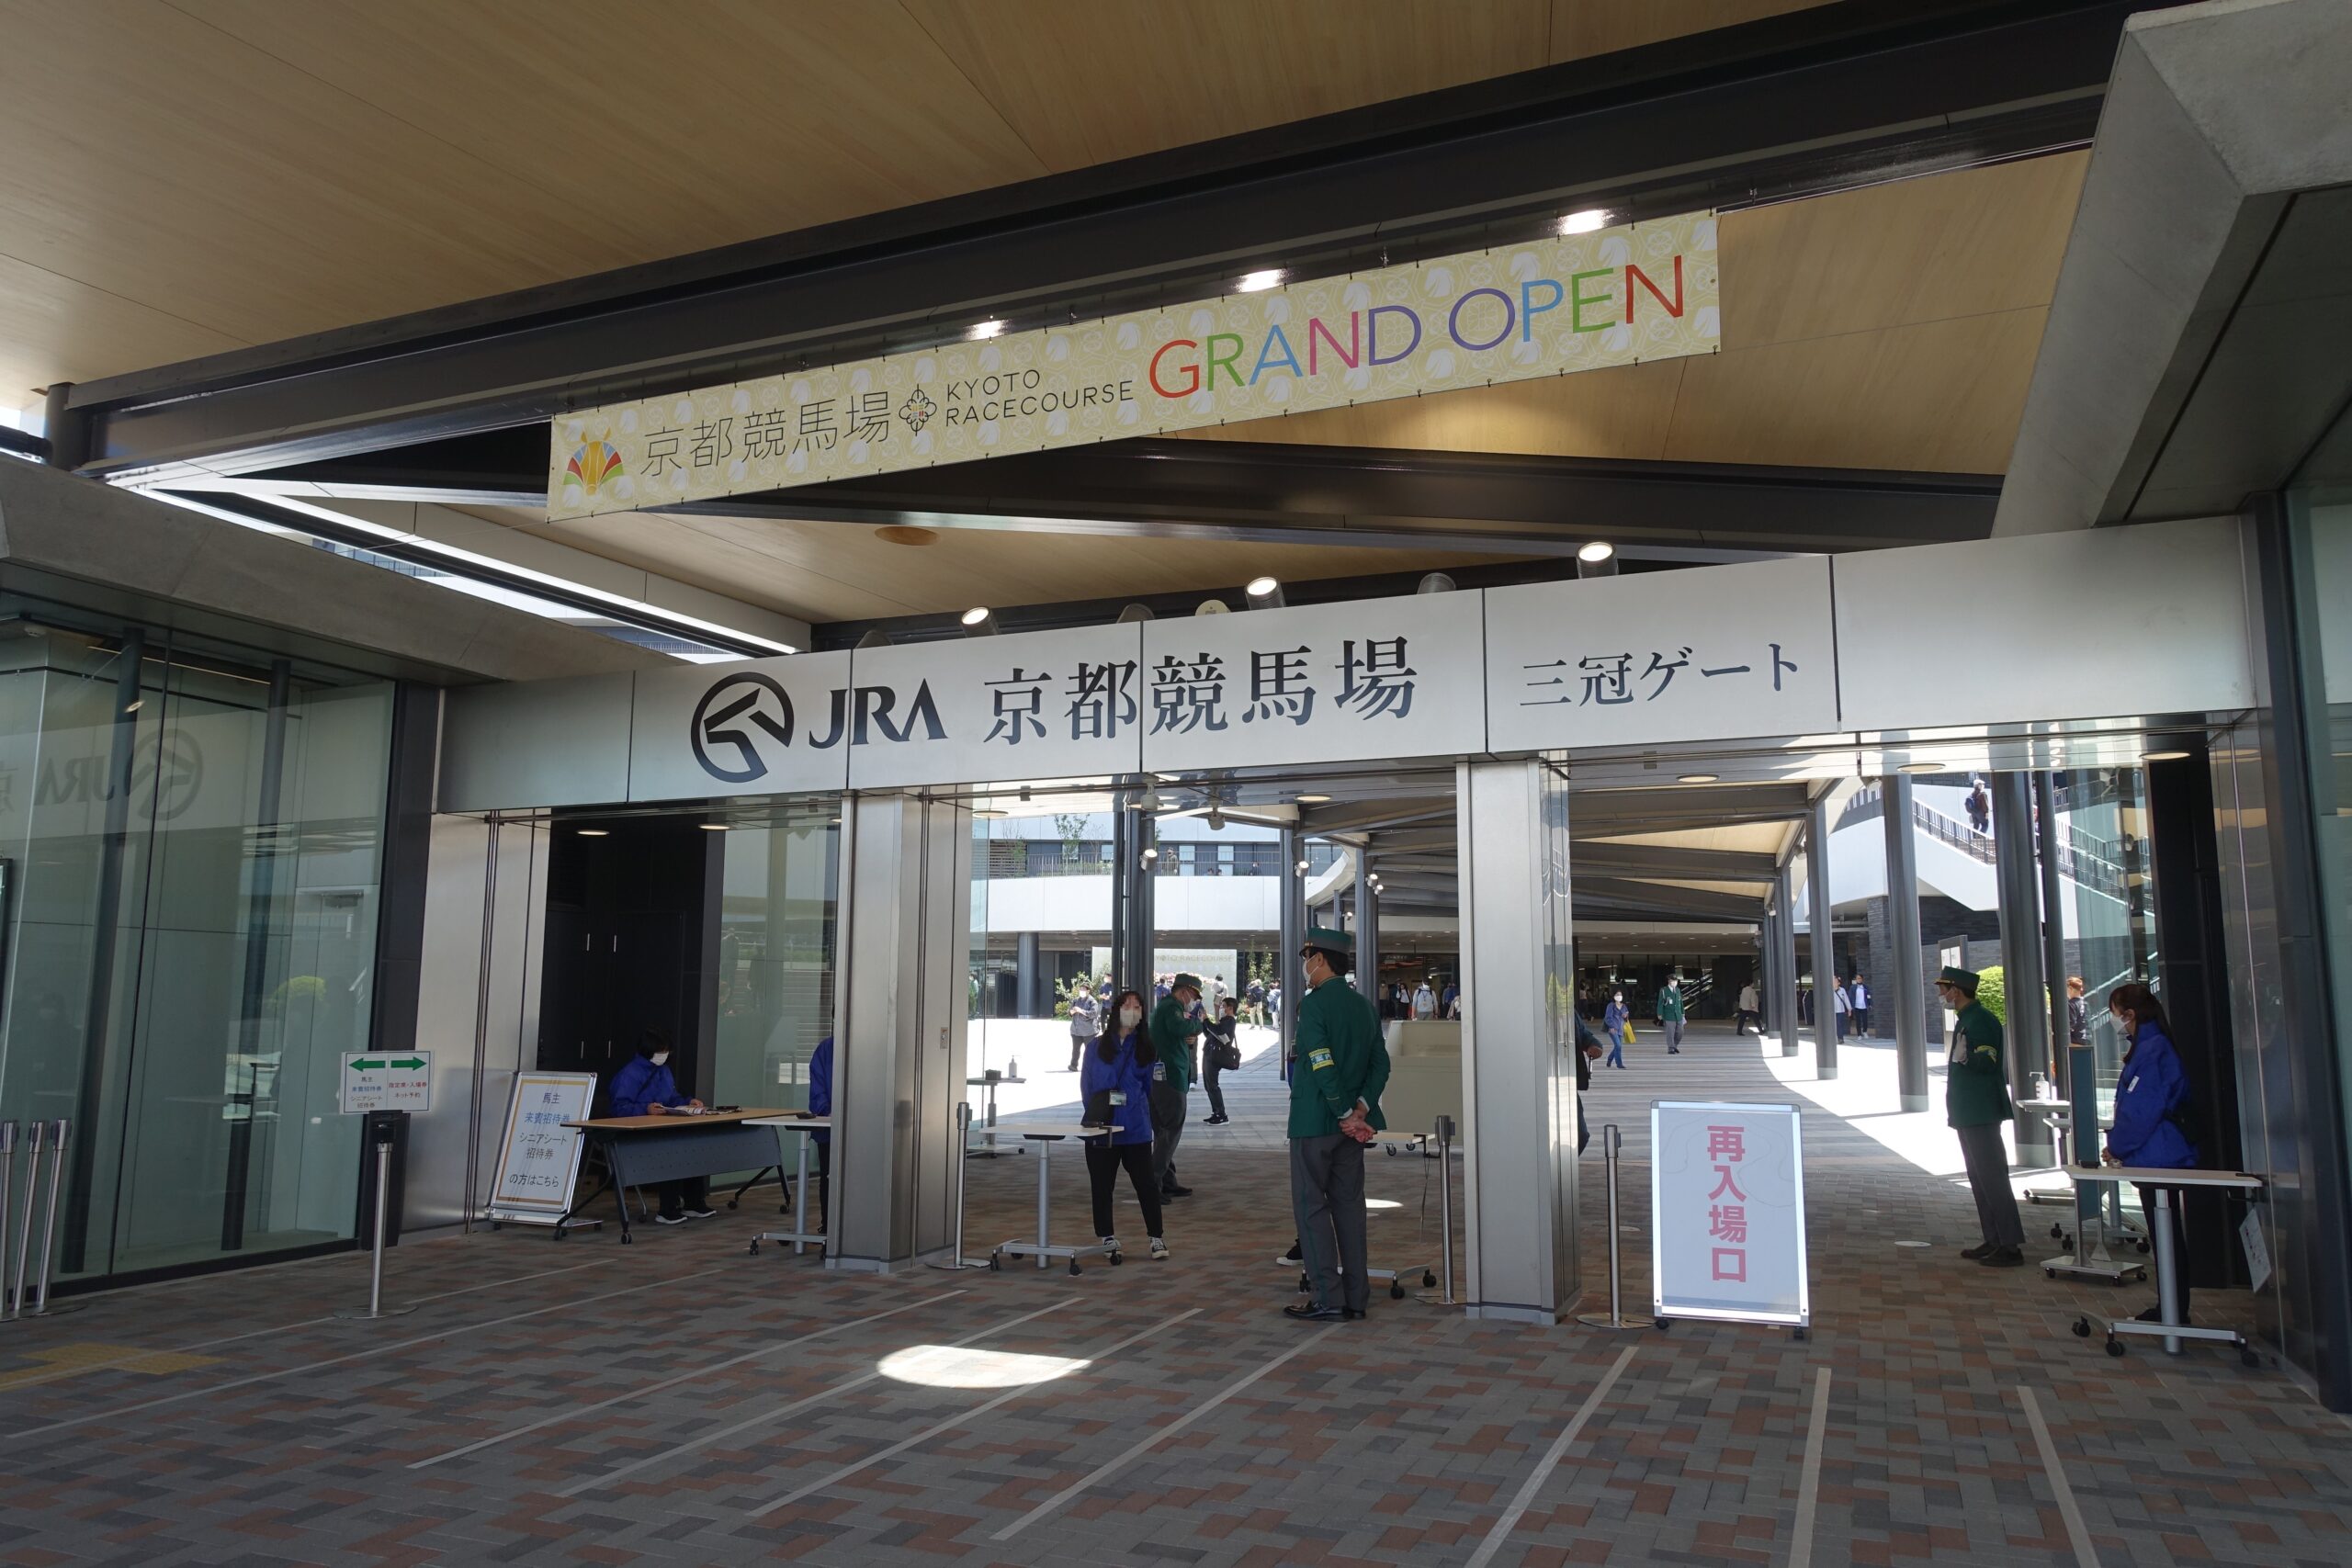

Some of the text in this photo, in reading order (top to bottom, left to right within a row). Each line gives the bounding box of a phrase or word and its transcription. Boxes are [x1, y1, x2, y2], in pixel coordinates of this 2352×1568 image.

[1148, 254, 1684, 399] GRAND OPEN
[946, 369, 1041, 401] KYOTO
[946, 380, 1134, 426] RACECOURSE
[639, 391, 890, 476] 京都競馬場
[983, 636, 1417, 745] 京都競馬場
[1520, 642, 1799, 708] 三冠ゲート
[808, 677, 948, 749] JRA
[542, 1092, 561, 1104] 馬主
[519, 1133, 567, 1145] シニアシート
[526, 1147, 555, 1159] 招待券
[509, 1174, 560, 1188] の方はこちら
[1706, 1125, 1747, 1282] 再入場口
